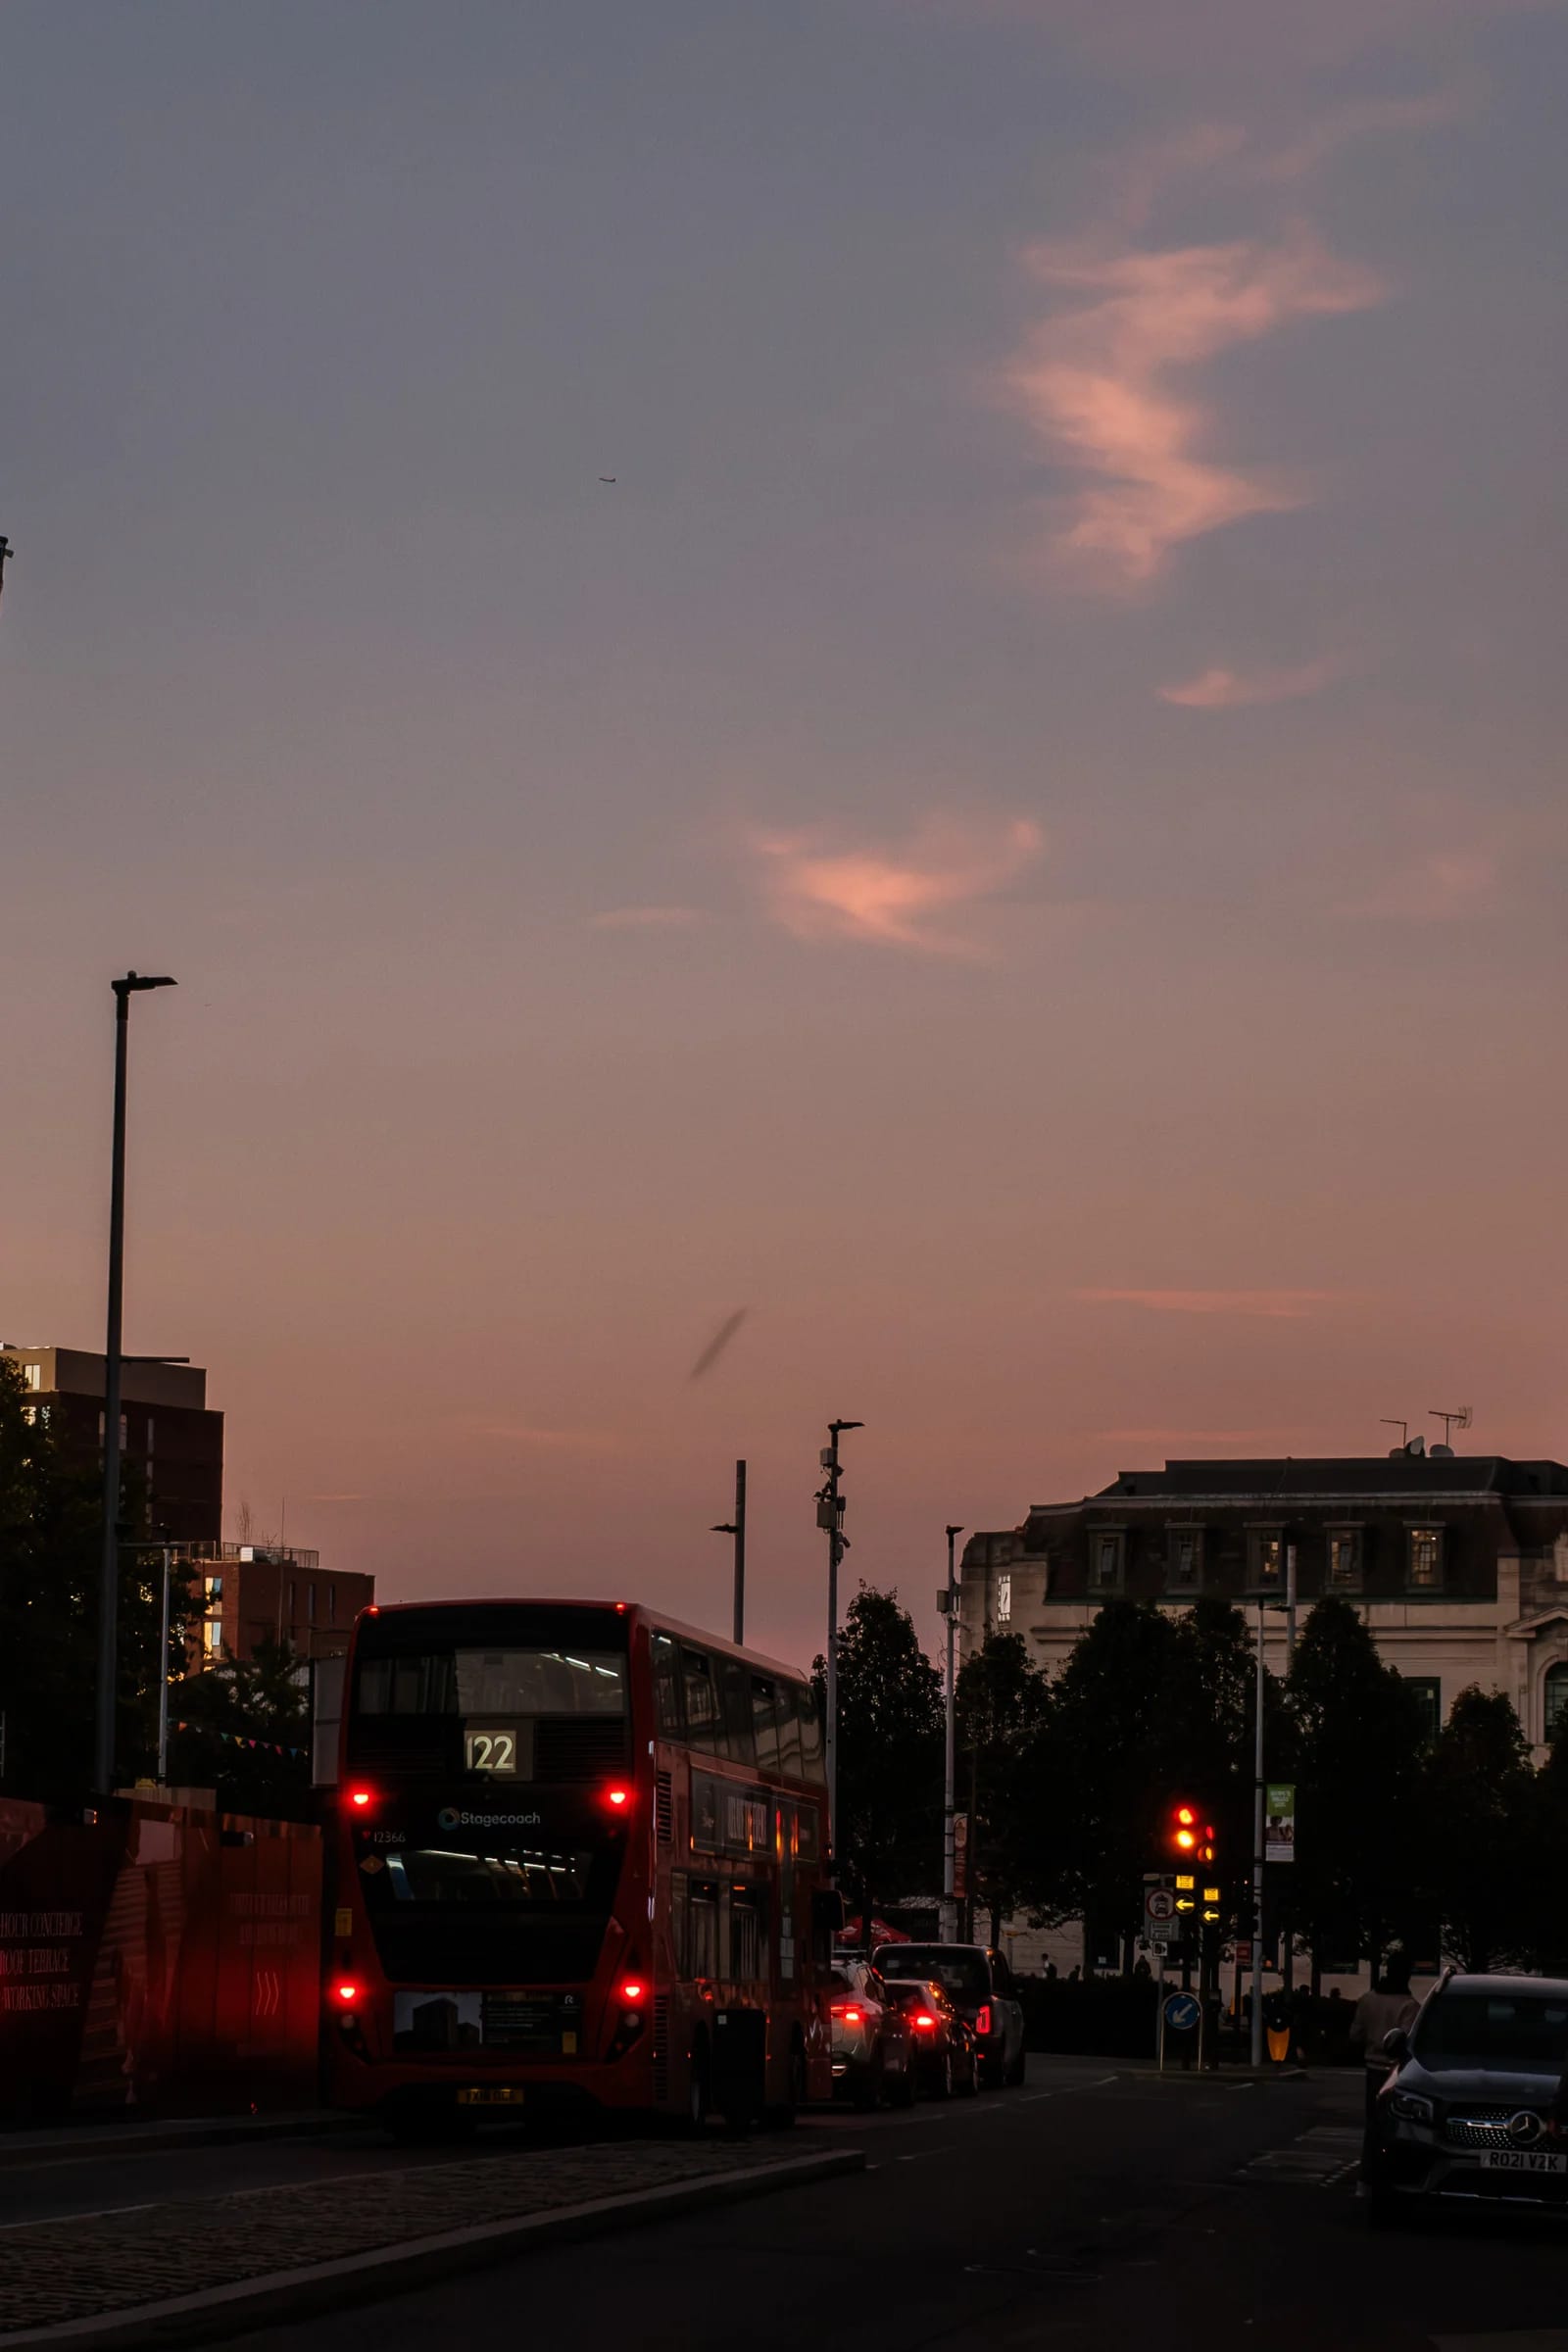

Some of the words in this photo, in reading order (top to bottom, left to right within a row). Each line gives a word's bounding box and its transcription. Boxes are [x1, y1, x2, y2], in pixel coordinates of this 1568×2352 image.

[466, 1735, 515, 1770] 122
[461, 1810, 542, 1828] Stagecoach
[373, 1830, 408, 1843] 12366
[28, 1947, 71, 1974] TERRACE
